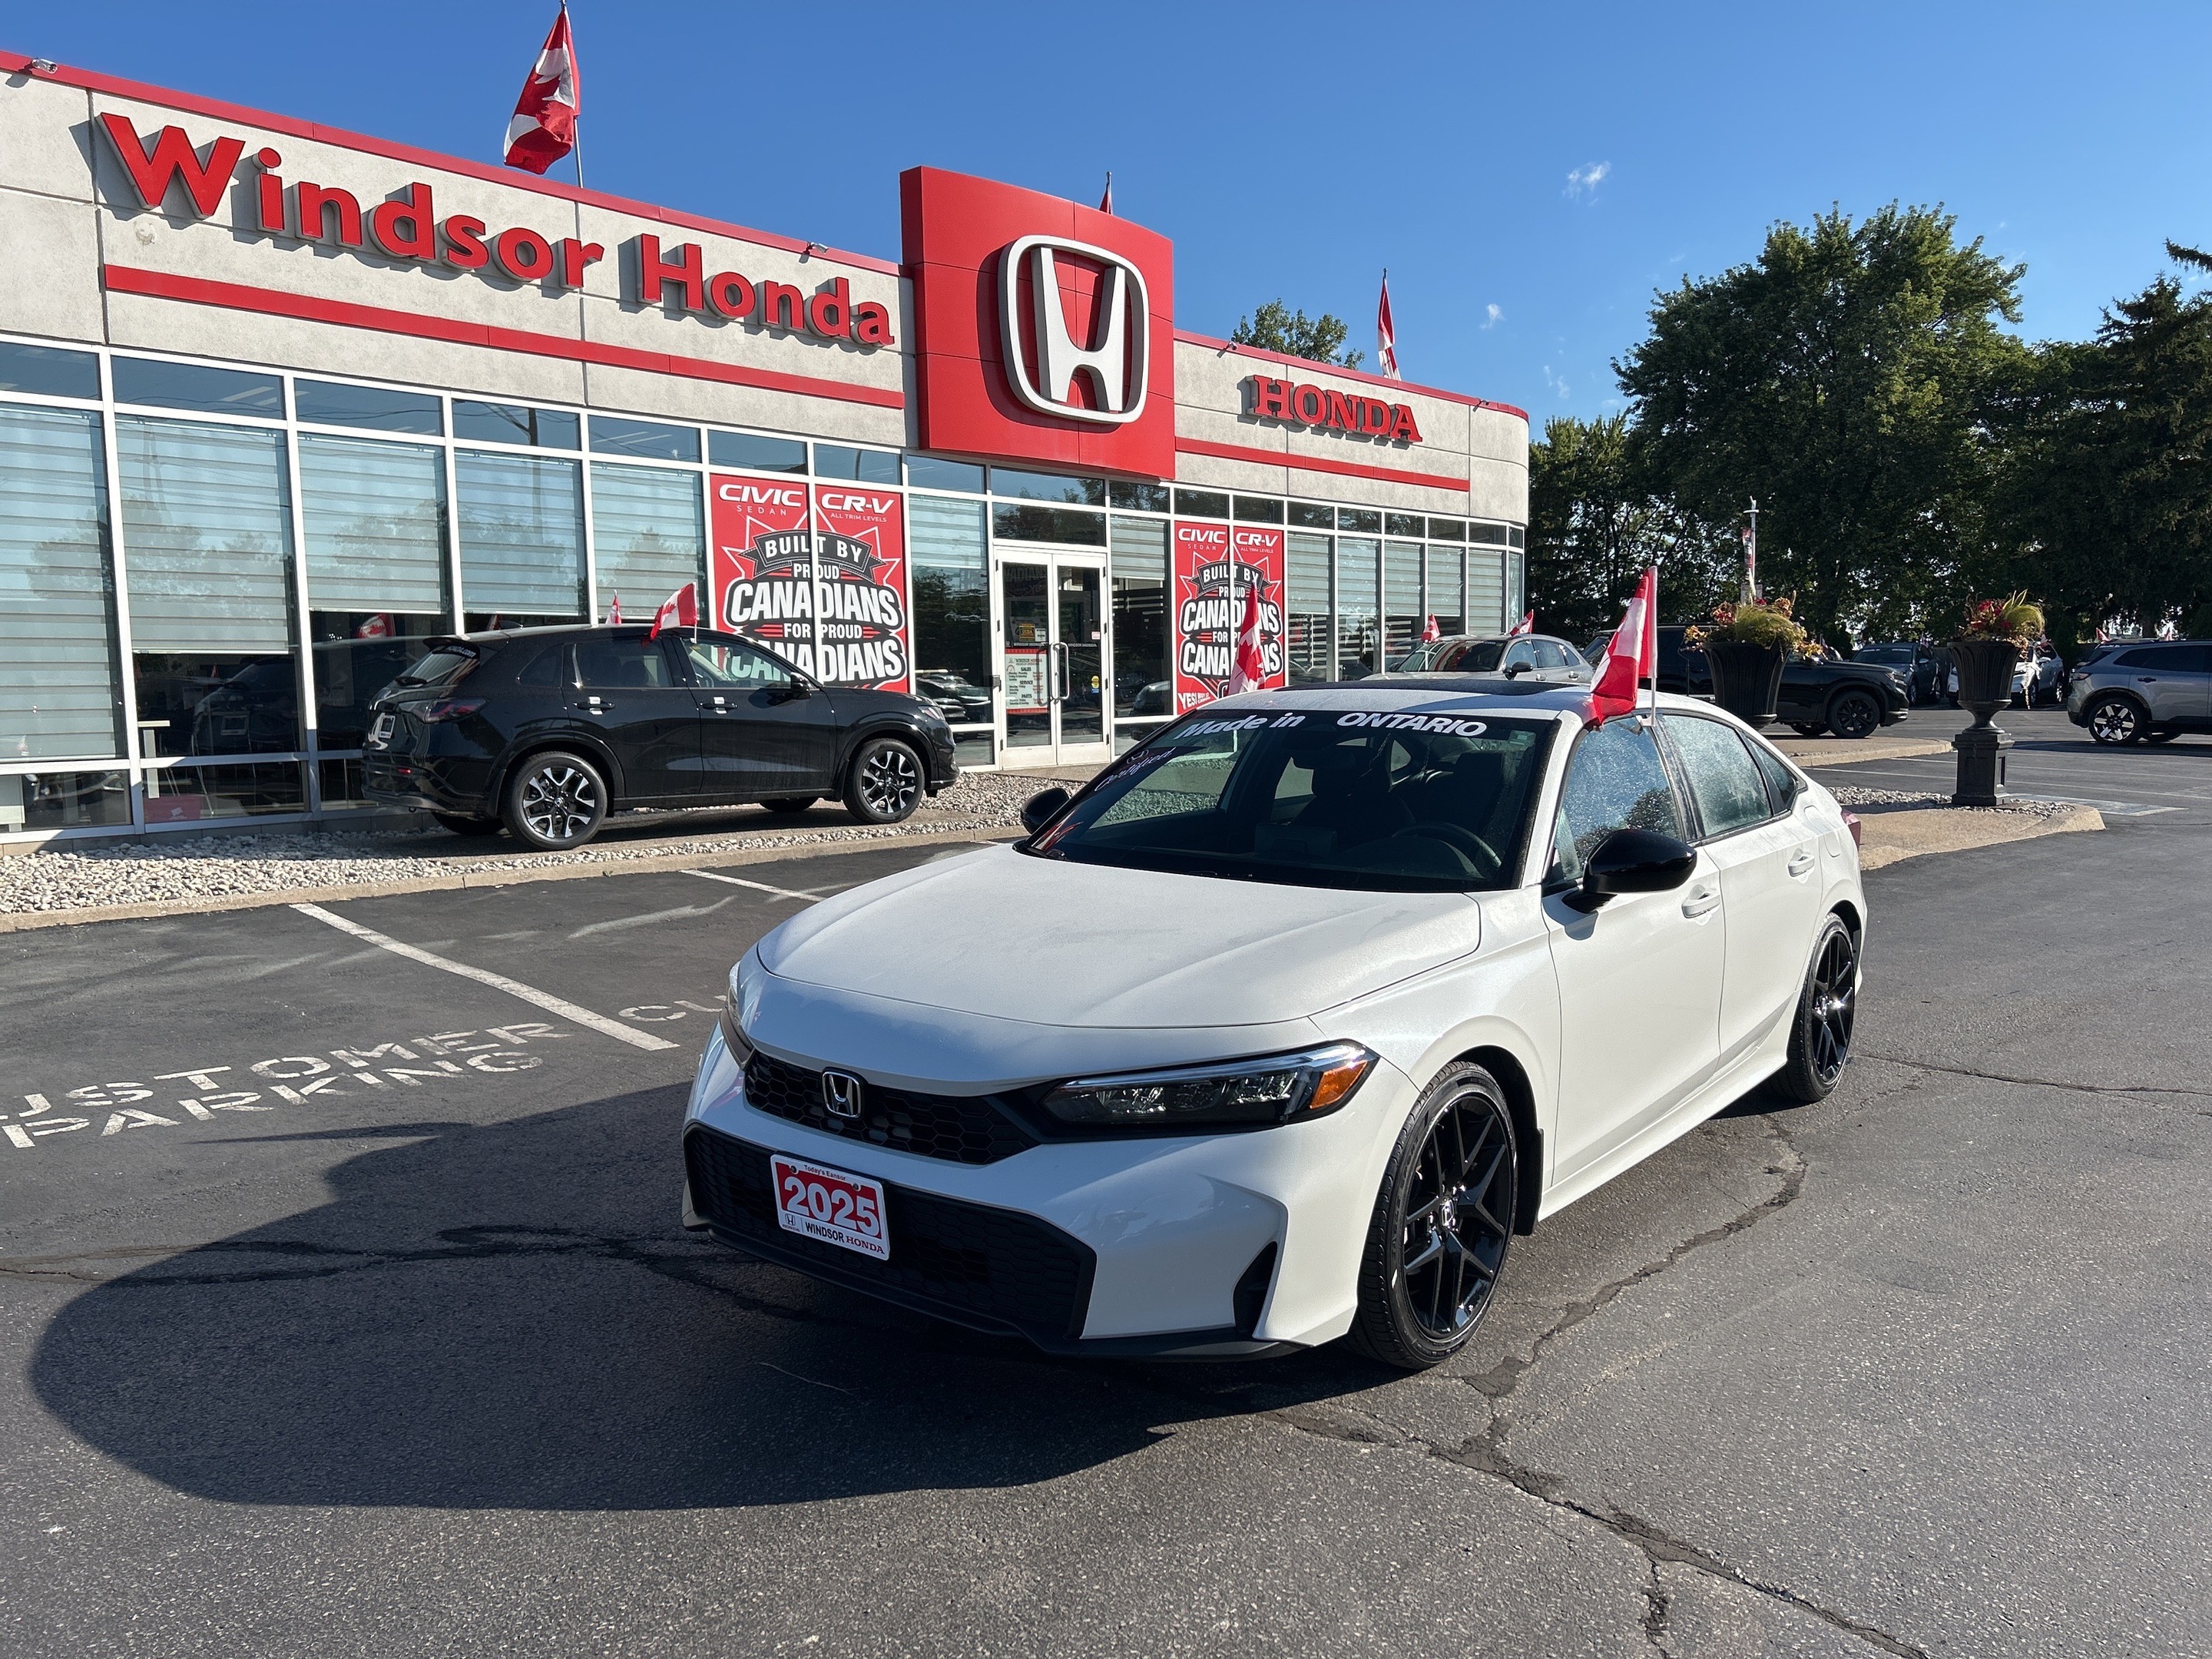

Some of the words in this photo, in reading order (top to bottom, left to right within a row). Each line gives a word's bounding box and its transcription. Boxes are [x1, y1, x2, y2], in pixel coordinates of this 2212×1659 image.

[97, 112, 604, 290] Windsor
[636, 233, 895, 347] Honda
[1250, 374, 1422, 443] HONDA
[718, 484, 803, 507] CIVIC
[821, 492, 894, 514] CR-V
[737, 505, 787, 516] SEDAN
[765, 535, 826, 558] BUILT
[836, 540, 863, 563] BY
[1178, 528, 1226, 544] CIVIC
[1236, 531, 1278, 548] CR-V
[1203, 565, 1238, 583] BUILT
[1244, 568, 1259, 584] BY
[730, 581, 896, 631] CANADIANS
[1183, 599, 1280, 633] CANADINS
[783, 623, 811, 638] FOR
[821, 624, 863, 639] PROUD
[1212, 631, 1228, 643] FOR
[1183, 642, 1281, 676] CANANS
[1173, 715, 1267, 740] Made
[1269, 712, 1306, 728] in
[1336, 713, 1487, 737] ONTARIO
[0, 1023, 574, 1120] USTOMER
[2, 1051, 543, 1148] PARKING
[803, 1164, 826, 1176] Today's
[784, 1177, 879, 1237] 2025
[805, 1222, 845, 1243] WINDSOR
[846, 1235, 886, 1254] HONDA
